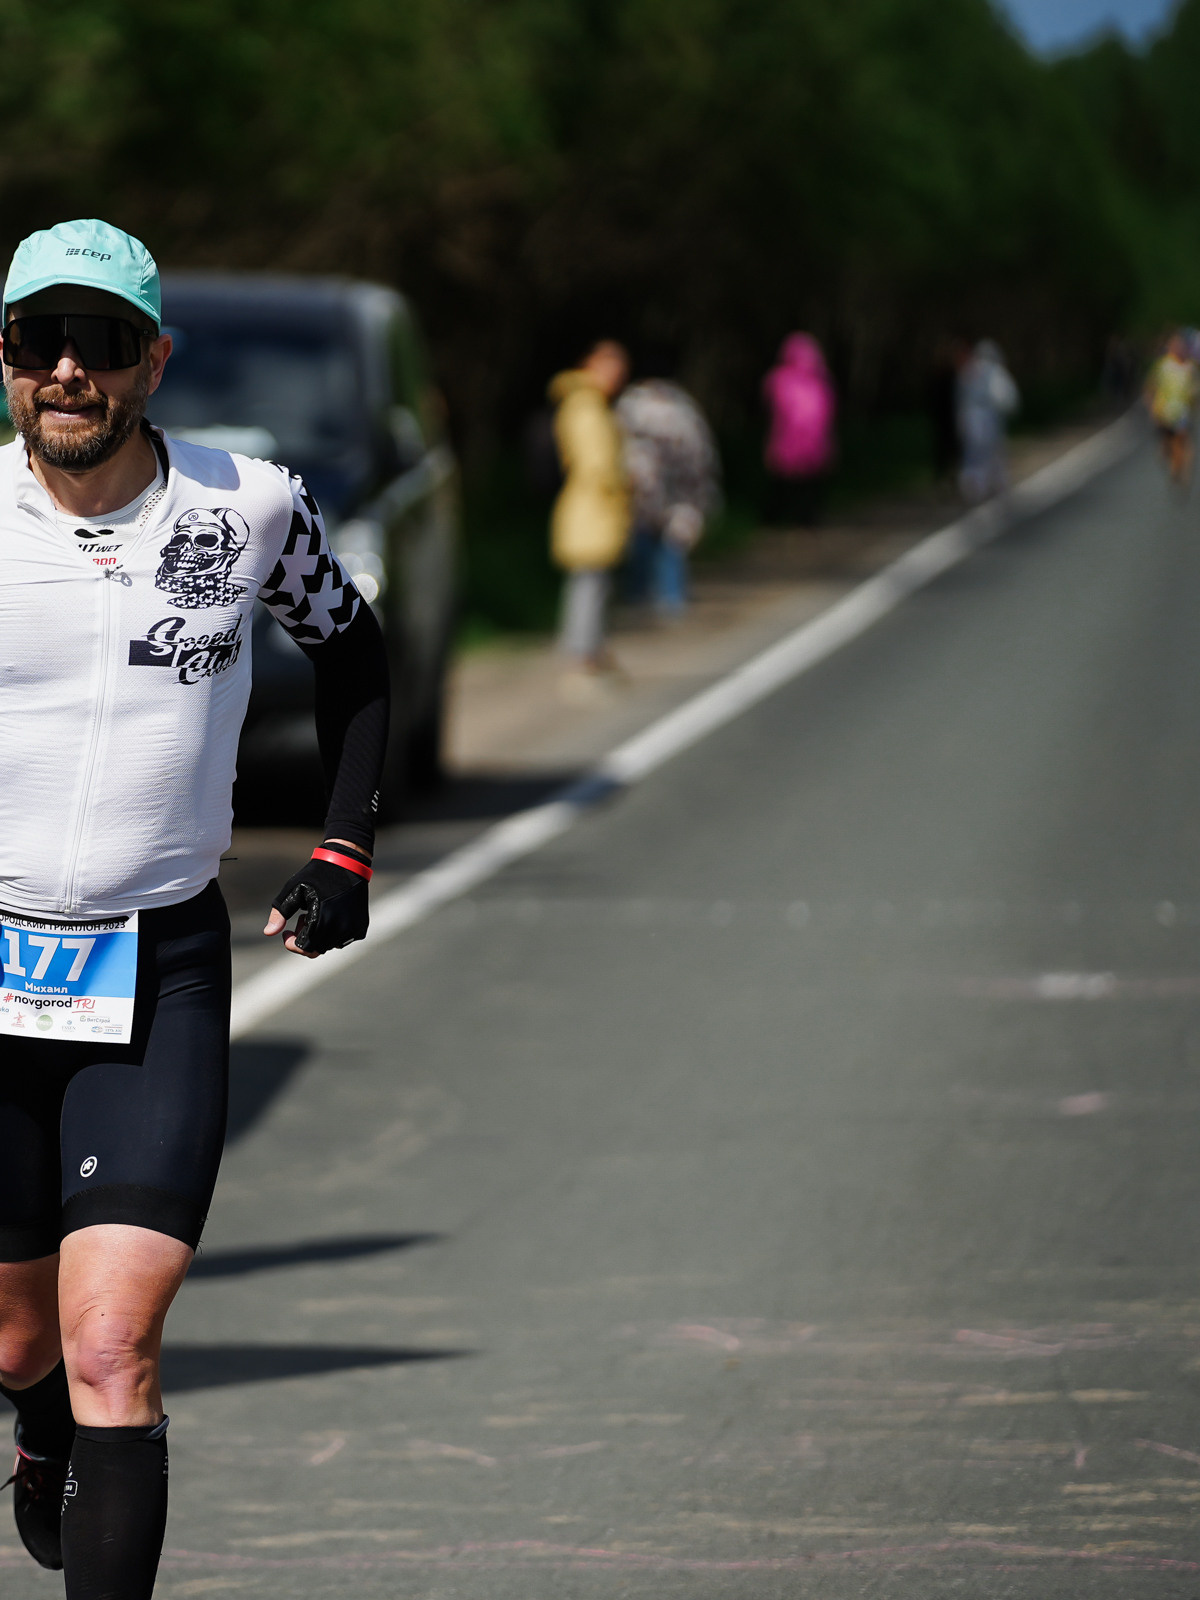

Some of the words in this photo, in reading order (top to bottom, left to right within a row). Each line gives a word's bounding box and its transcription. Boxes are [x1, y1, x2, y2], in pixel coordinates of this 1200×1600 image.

[141, 612, 243, 669] Speed
[173, 632, 244, 686] Club
[102, 921, 126, 931] 2023
[3, 928, 97, 982] 177
[25, 981, 68, 994] Михаил
